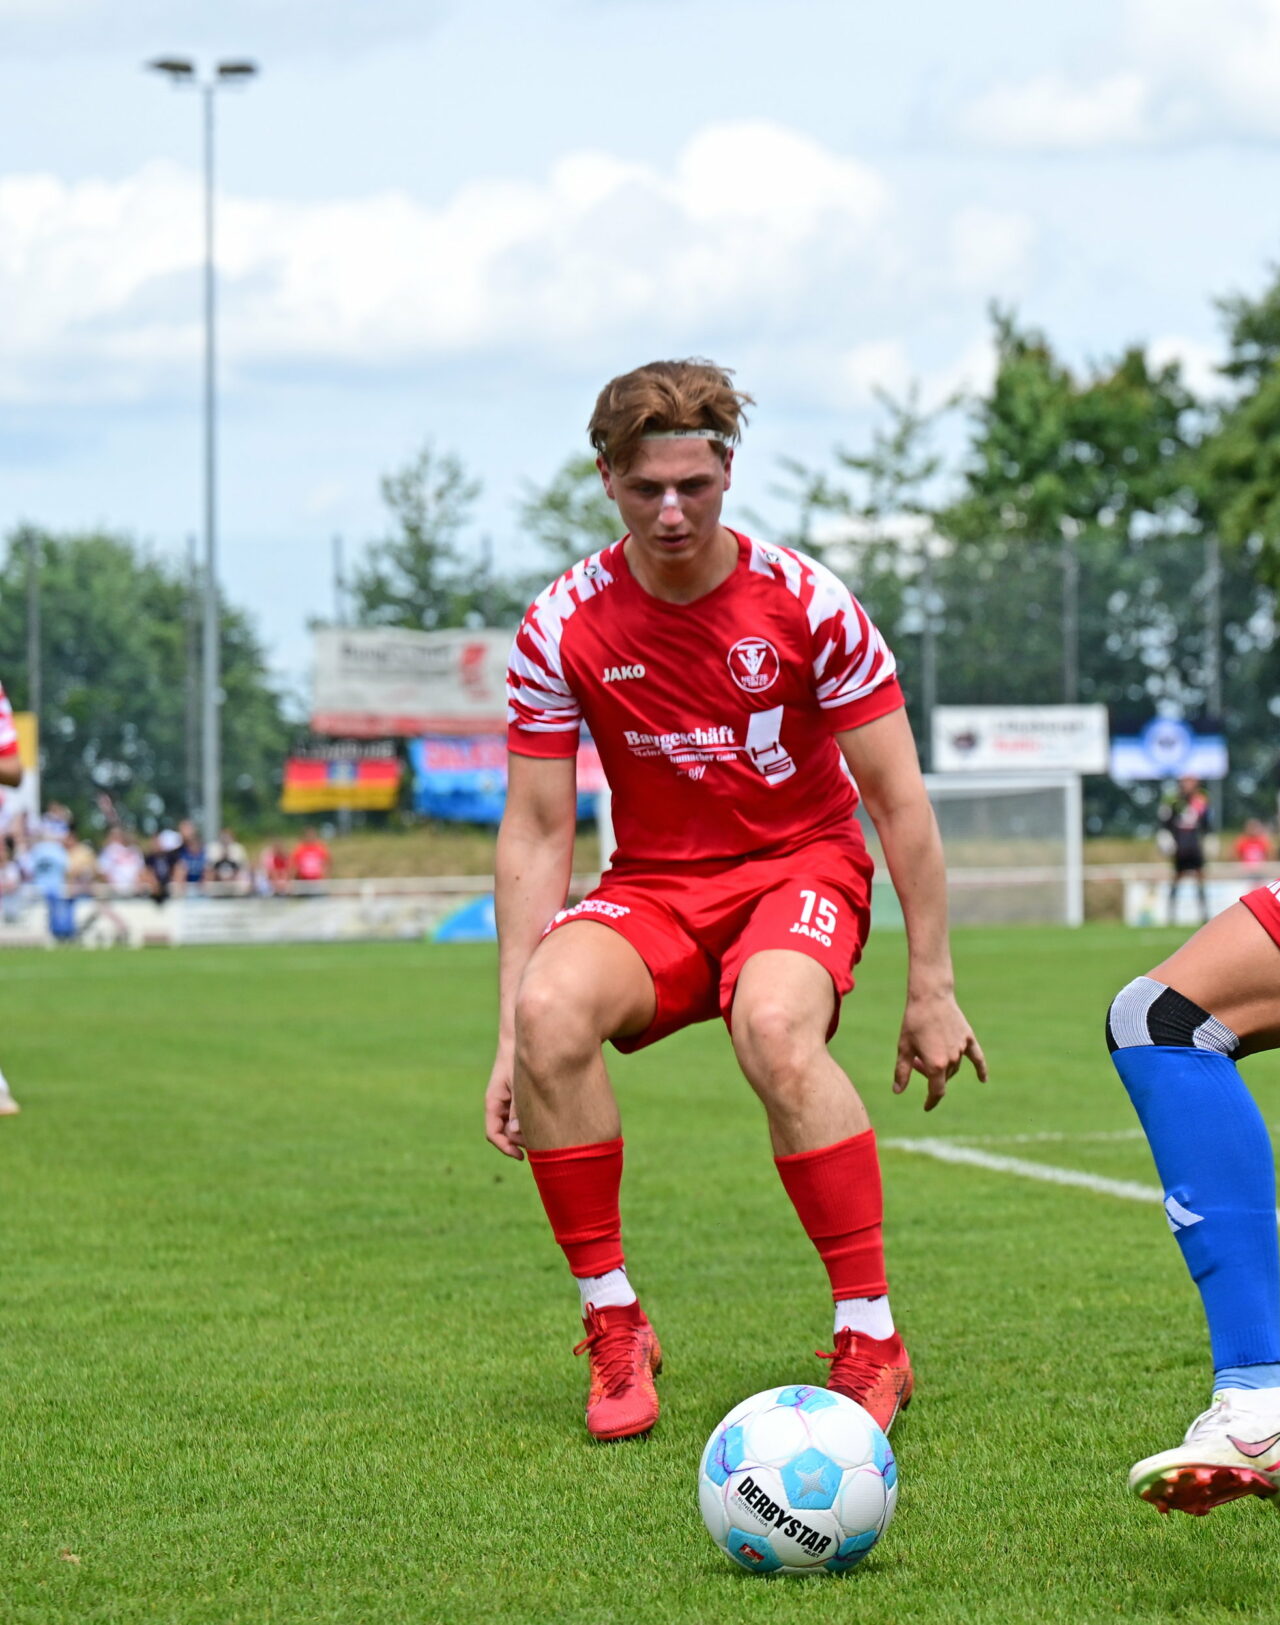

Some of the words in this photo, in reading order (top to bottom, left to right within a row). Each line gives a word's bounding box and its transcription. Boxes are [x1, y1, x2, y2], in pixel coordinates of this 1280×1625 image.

[602, 663, 646, 683] JAKO
[800, 890, 838, 934] 15
[789, 922, 832, 948] JAKO
[737, 1476, 832, 1554] DERBYSTAR
